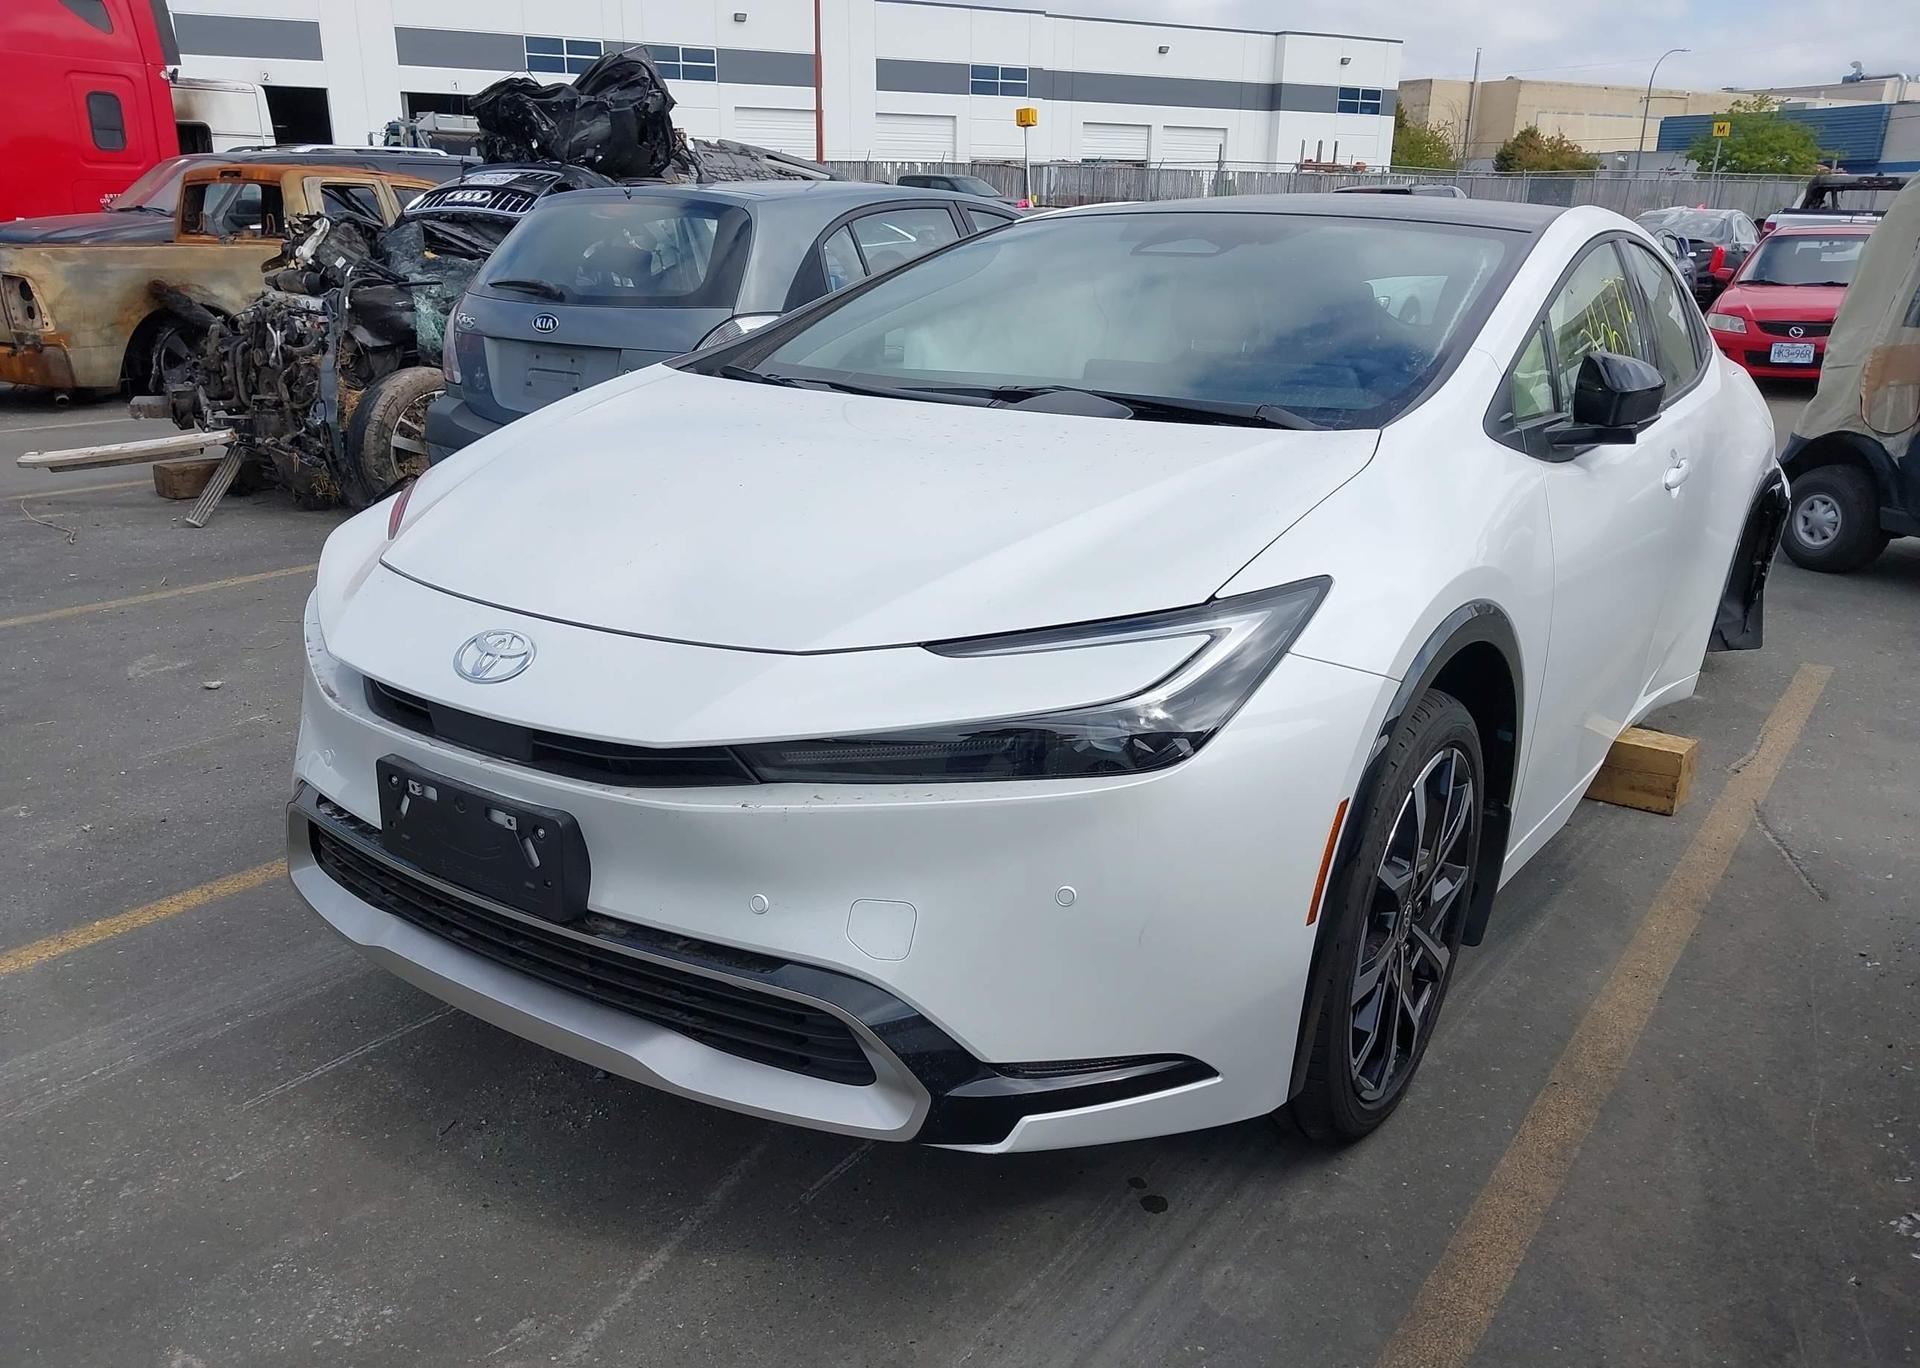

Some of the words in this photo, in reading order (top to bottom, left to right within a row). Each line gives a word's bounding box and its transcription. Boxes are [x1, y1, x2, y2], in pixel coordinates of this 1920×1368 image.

[263, 72, 269, 81] 2
[1716, 124, 1726, 135] M
[535, 316, 554, 330] KIA
